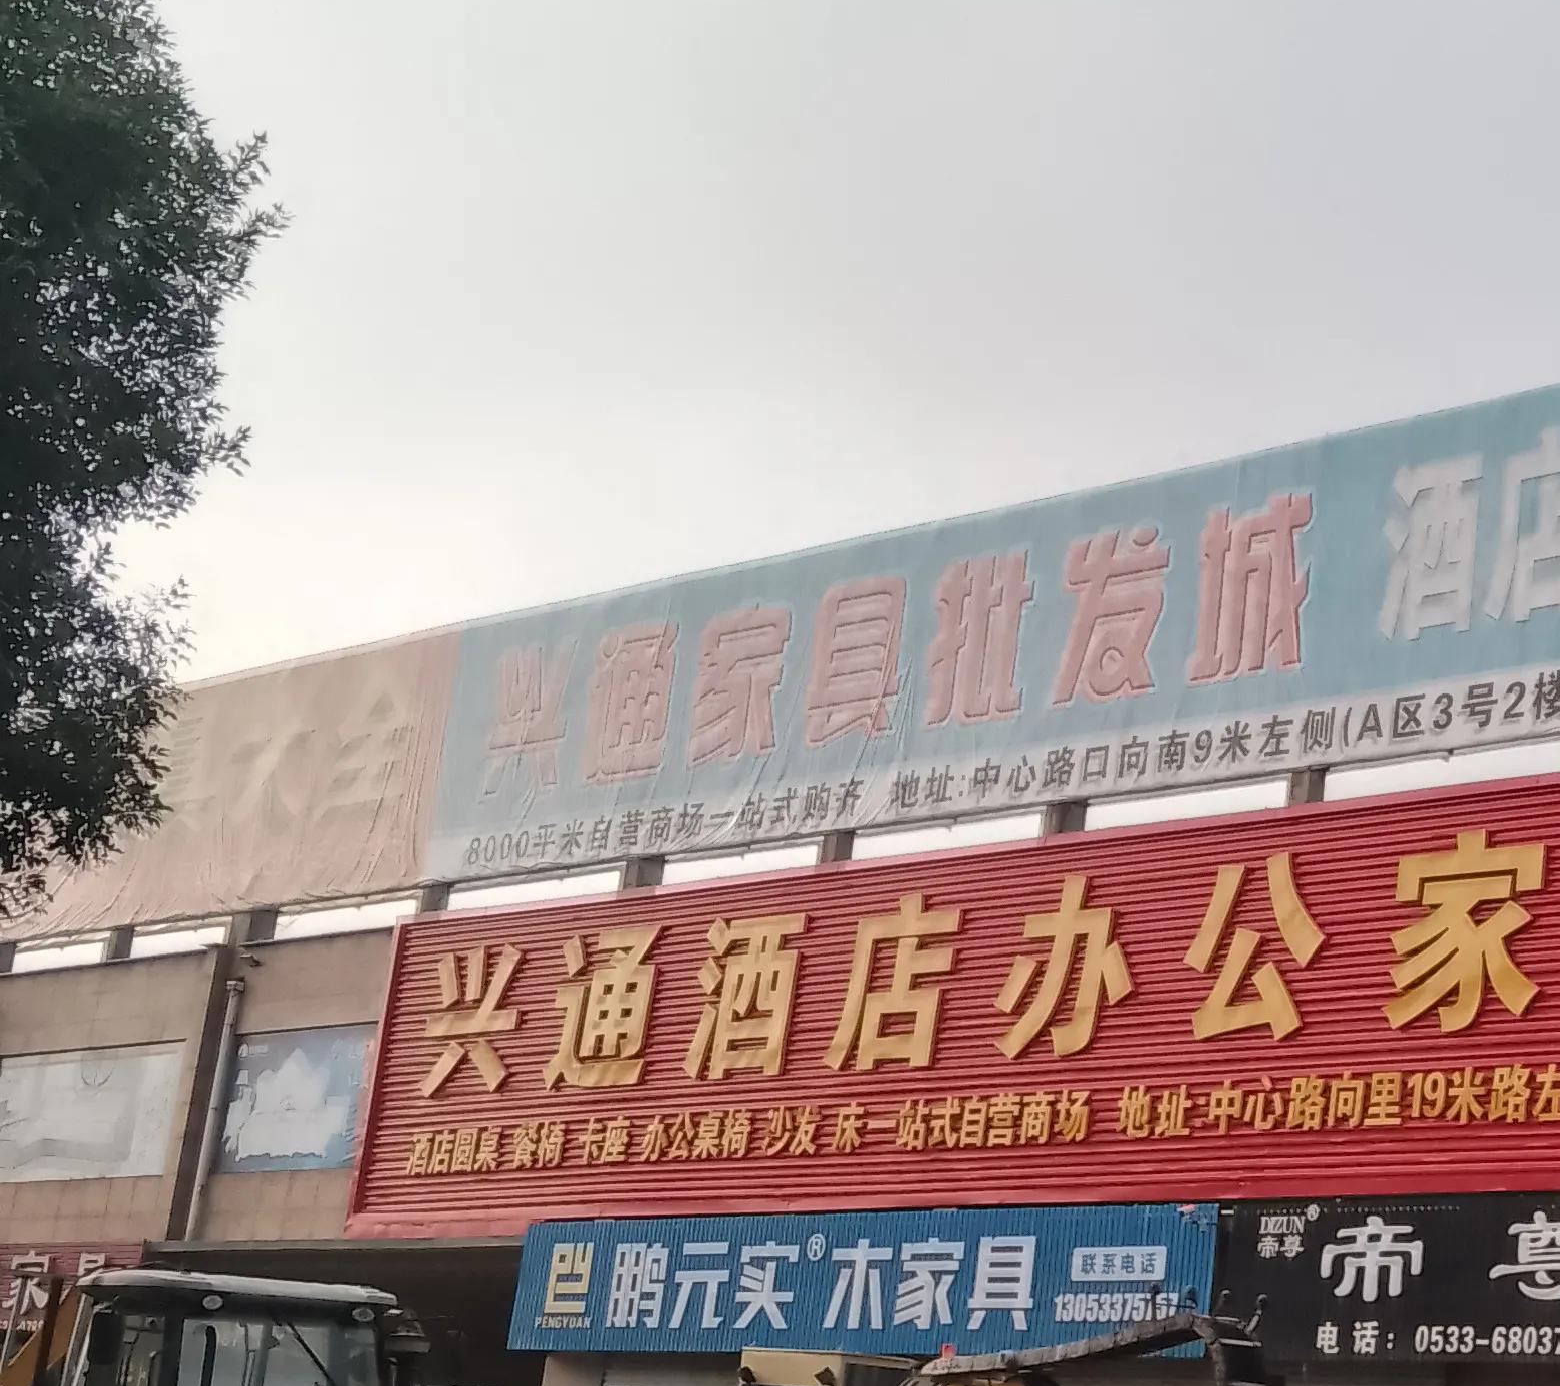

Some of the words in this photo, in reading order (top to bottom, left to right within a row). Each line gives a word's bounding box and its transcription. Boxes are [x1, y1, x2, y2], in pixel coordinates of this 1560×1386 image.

[1258, 1216, 1307, 1234] DIZUN
[1256, 1235, 1306, 1260] 帝尊
[1081, 1252, 1157, 1276] 联系电话
